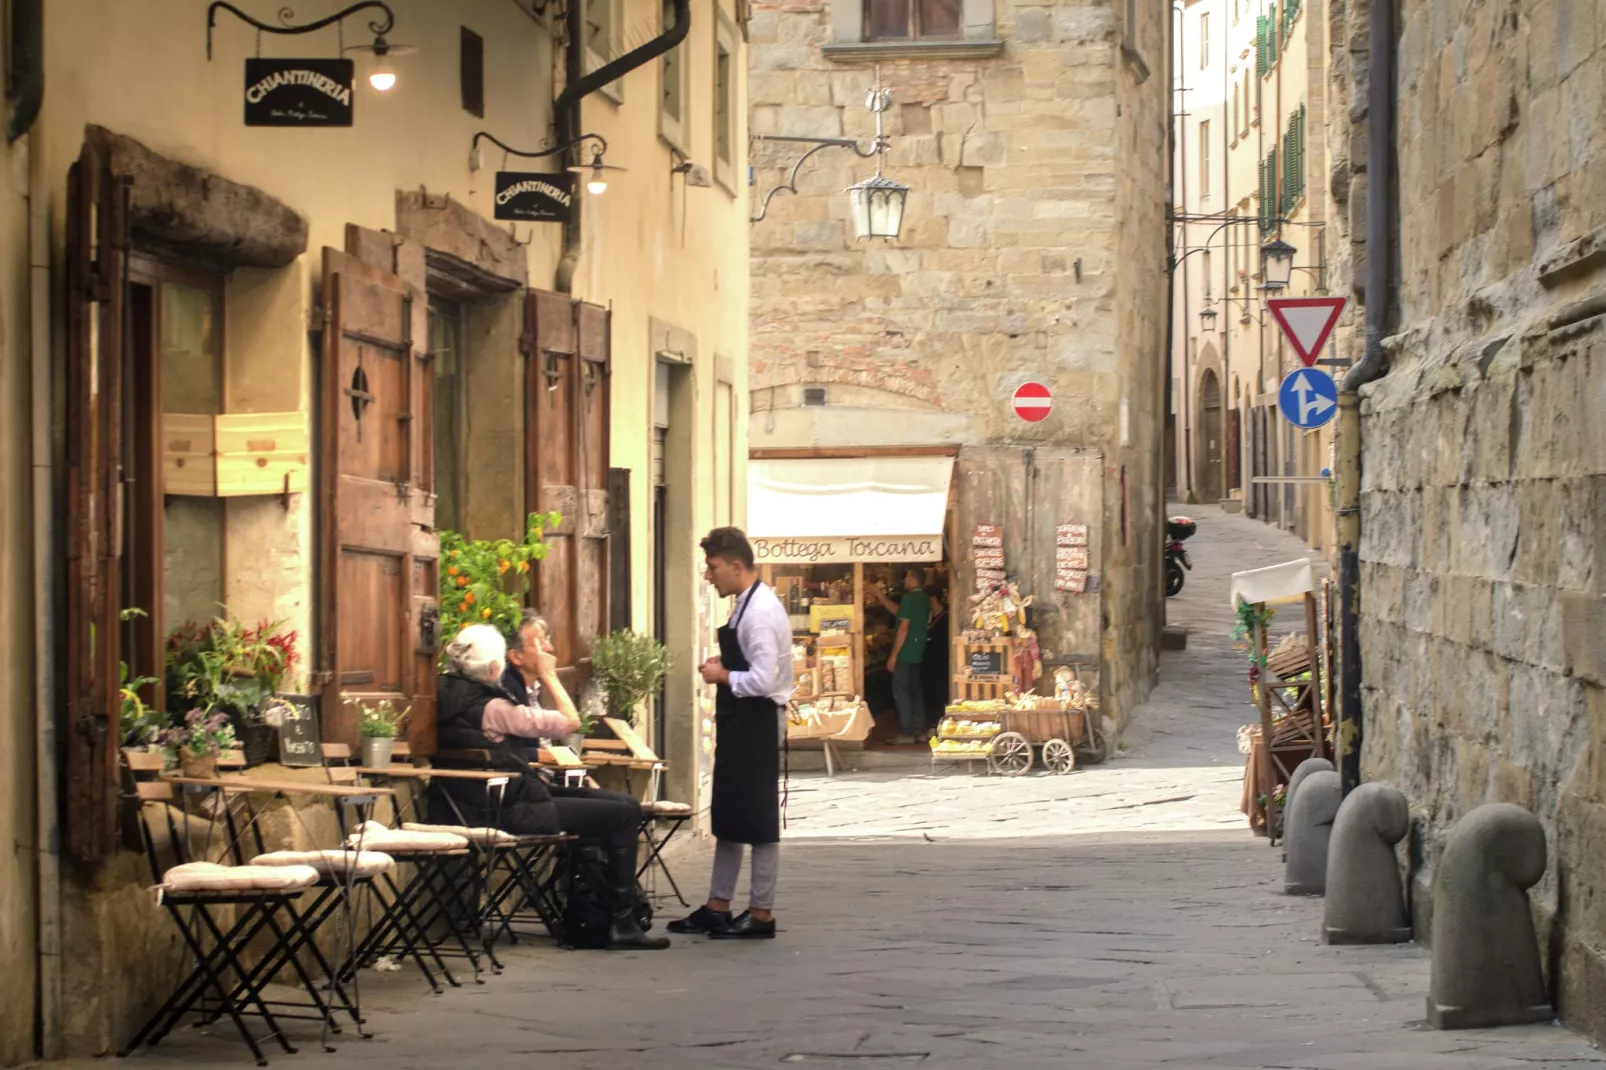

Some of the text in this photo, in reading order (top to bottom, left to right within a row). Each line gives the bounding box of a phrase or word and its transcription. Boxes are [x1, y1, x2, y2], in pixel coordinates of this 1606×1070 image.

[246, 69, 350, 106] CHIANTINERIA
[496, 180, 571, 207] CHIANTINERIA
[754, 536, 935, 561] Bottega Toscana
